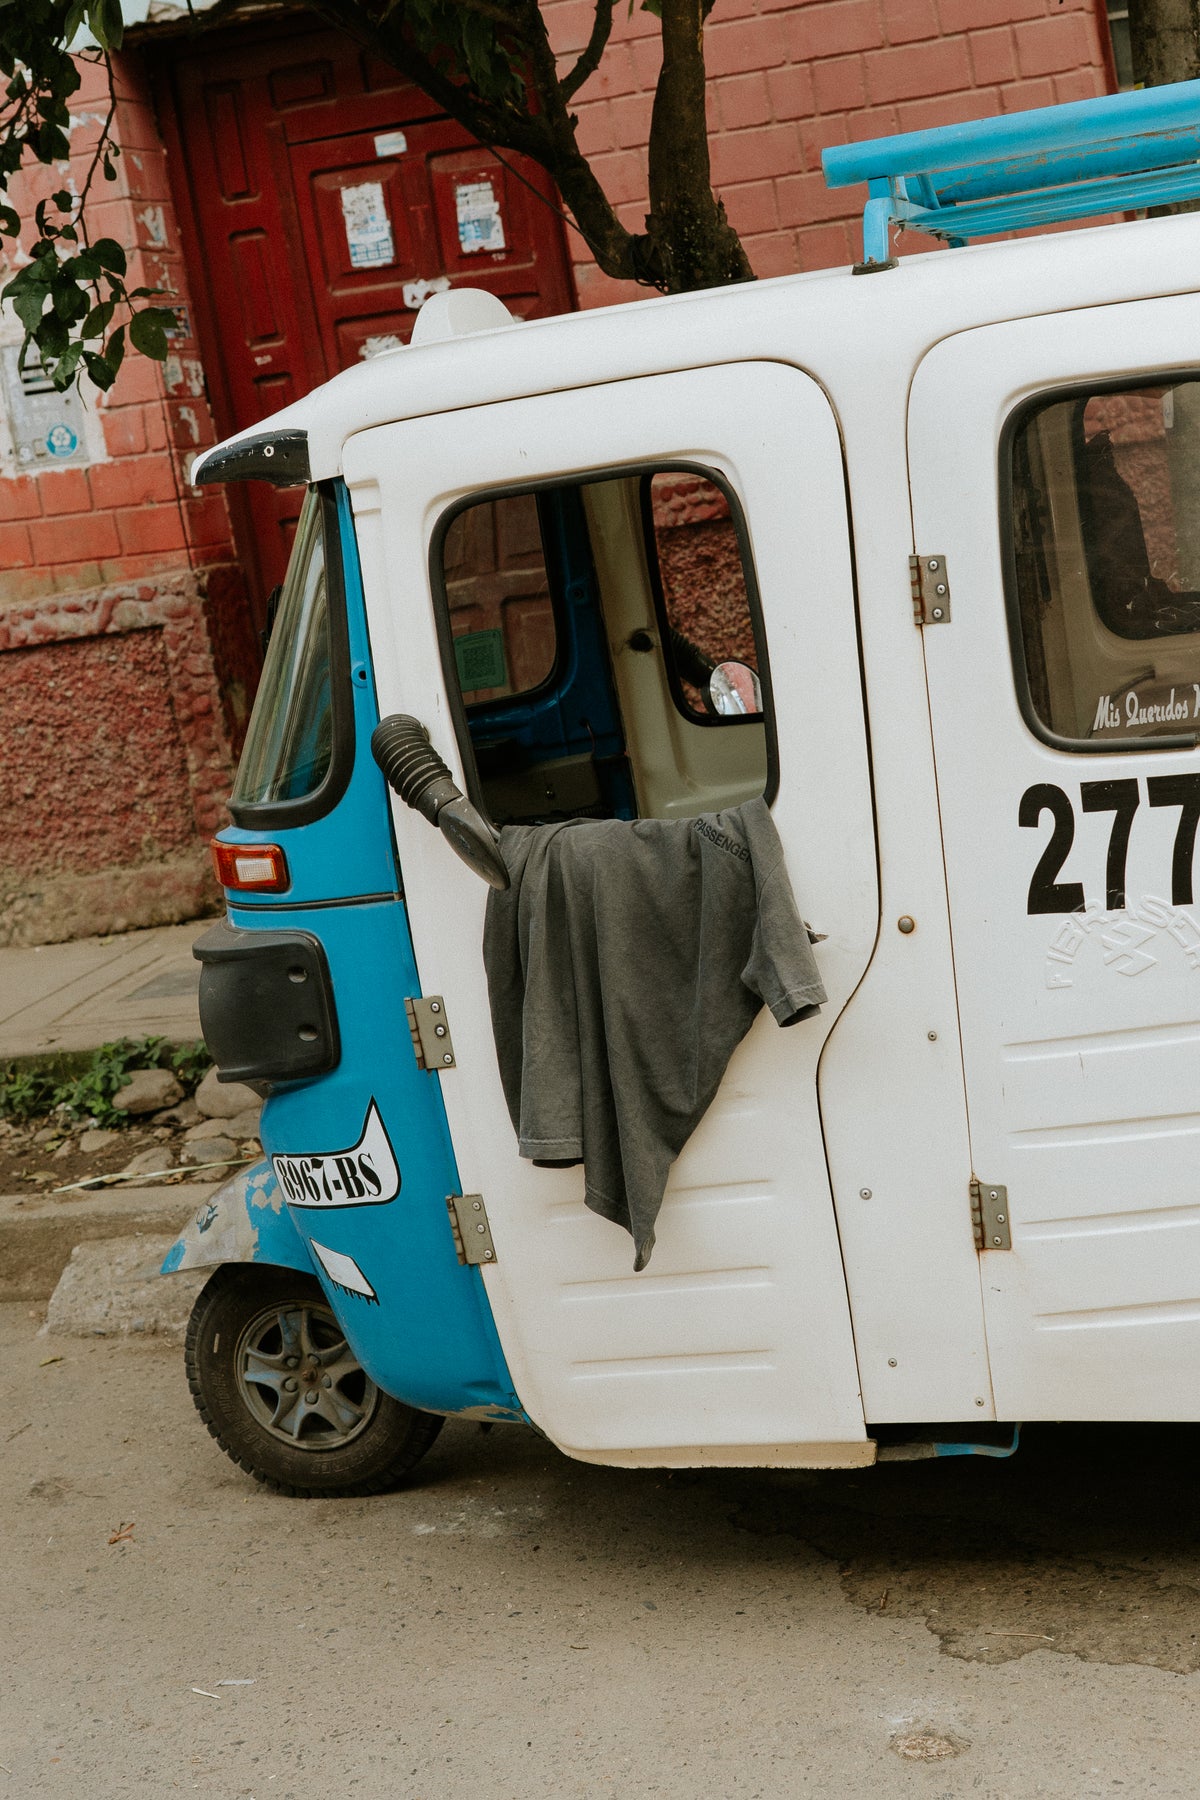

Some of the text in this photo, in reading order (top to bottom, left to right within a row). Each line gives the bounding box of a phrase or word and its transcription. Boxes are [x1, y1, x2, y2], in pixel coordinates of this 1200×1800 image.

[1092, 695, 1120, 731] Mis
[1125, 688, 1189, 727] Queridos
[1018, 773, 1200, 915] 277
[277, 1153, 382, 1201] 8967-BS
